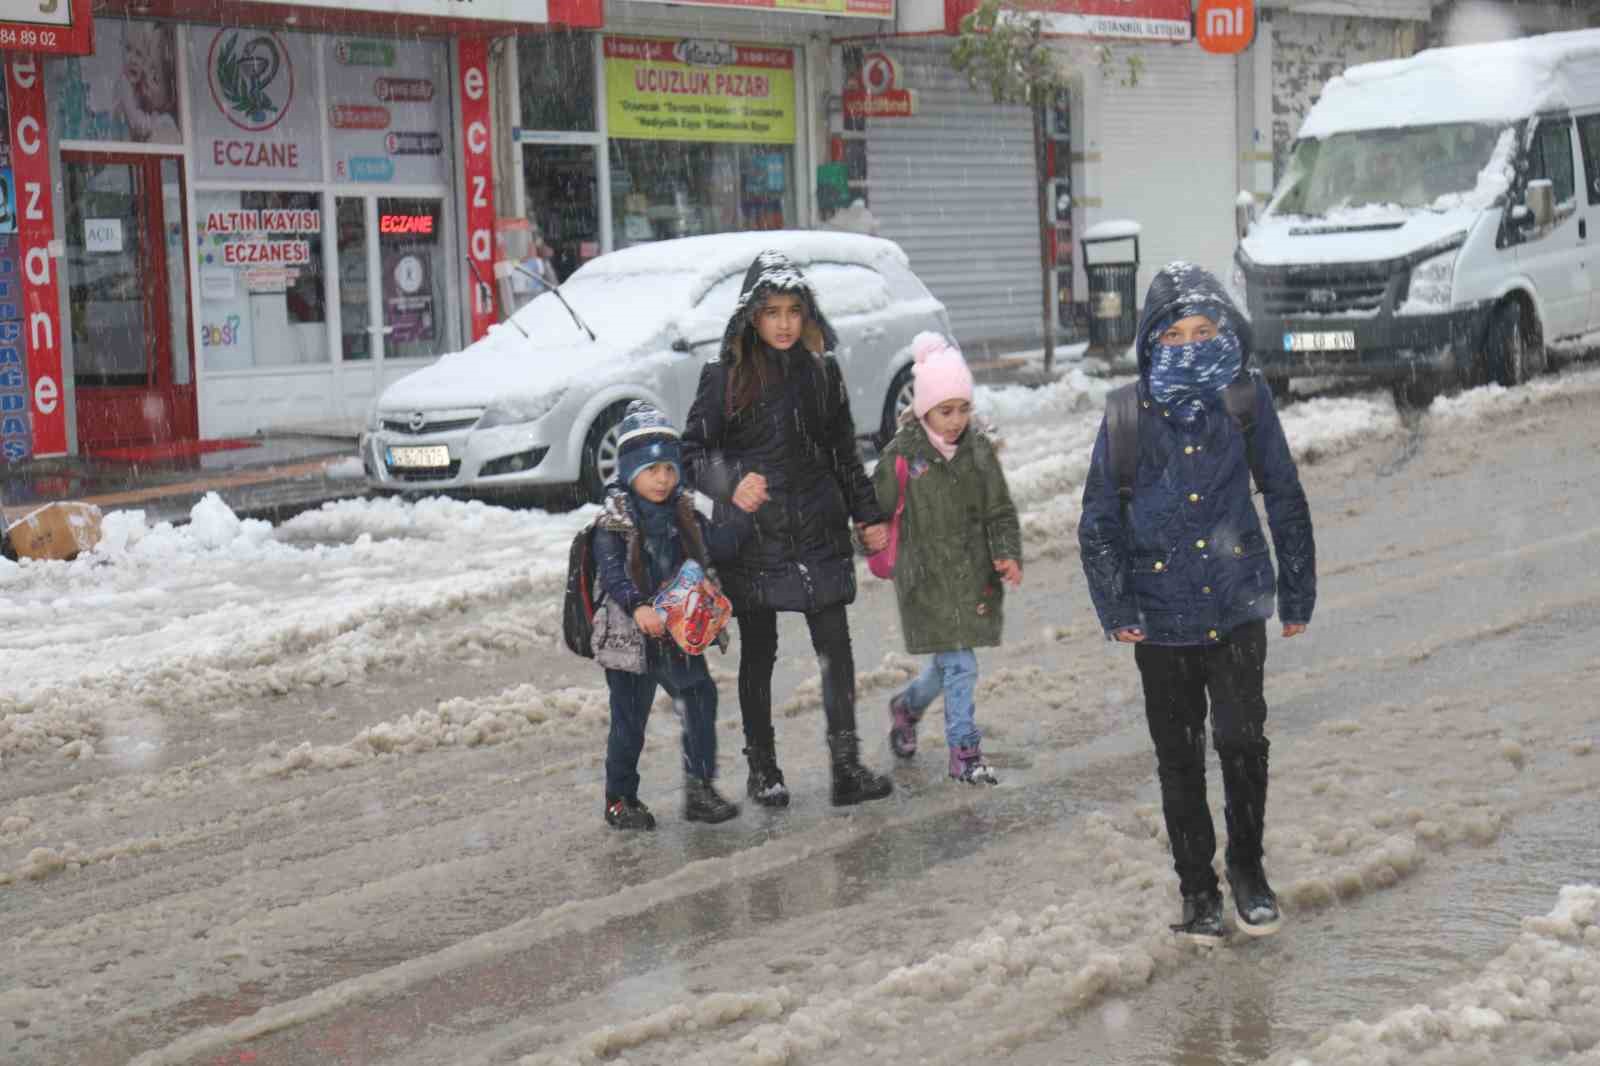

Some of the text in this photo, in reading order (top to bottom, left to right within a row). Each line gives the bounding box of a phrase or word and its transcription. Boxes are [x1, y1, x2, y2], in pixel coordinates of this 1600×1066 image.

[20, 30, 37, 46] 89
[40, 31, 57, 47] 02
[635, 67, 769, 97] UCUZLUK PAZARI
[213, 141, 298, 168] ECZANE
[464, 67, 493, 315] eczan
[12, 52, 58, 414] eczane
[207, 210, 319, 232] ALTIN KAYISI
[380, 216, 433, 233] ECZANE
[223, 242, 309, 263] ECZANESİ
